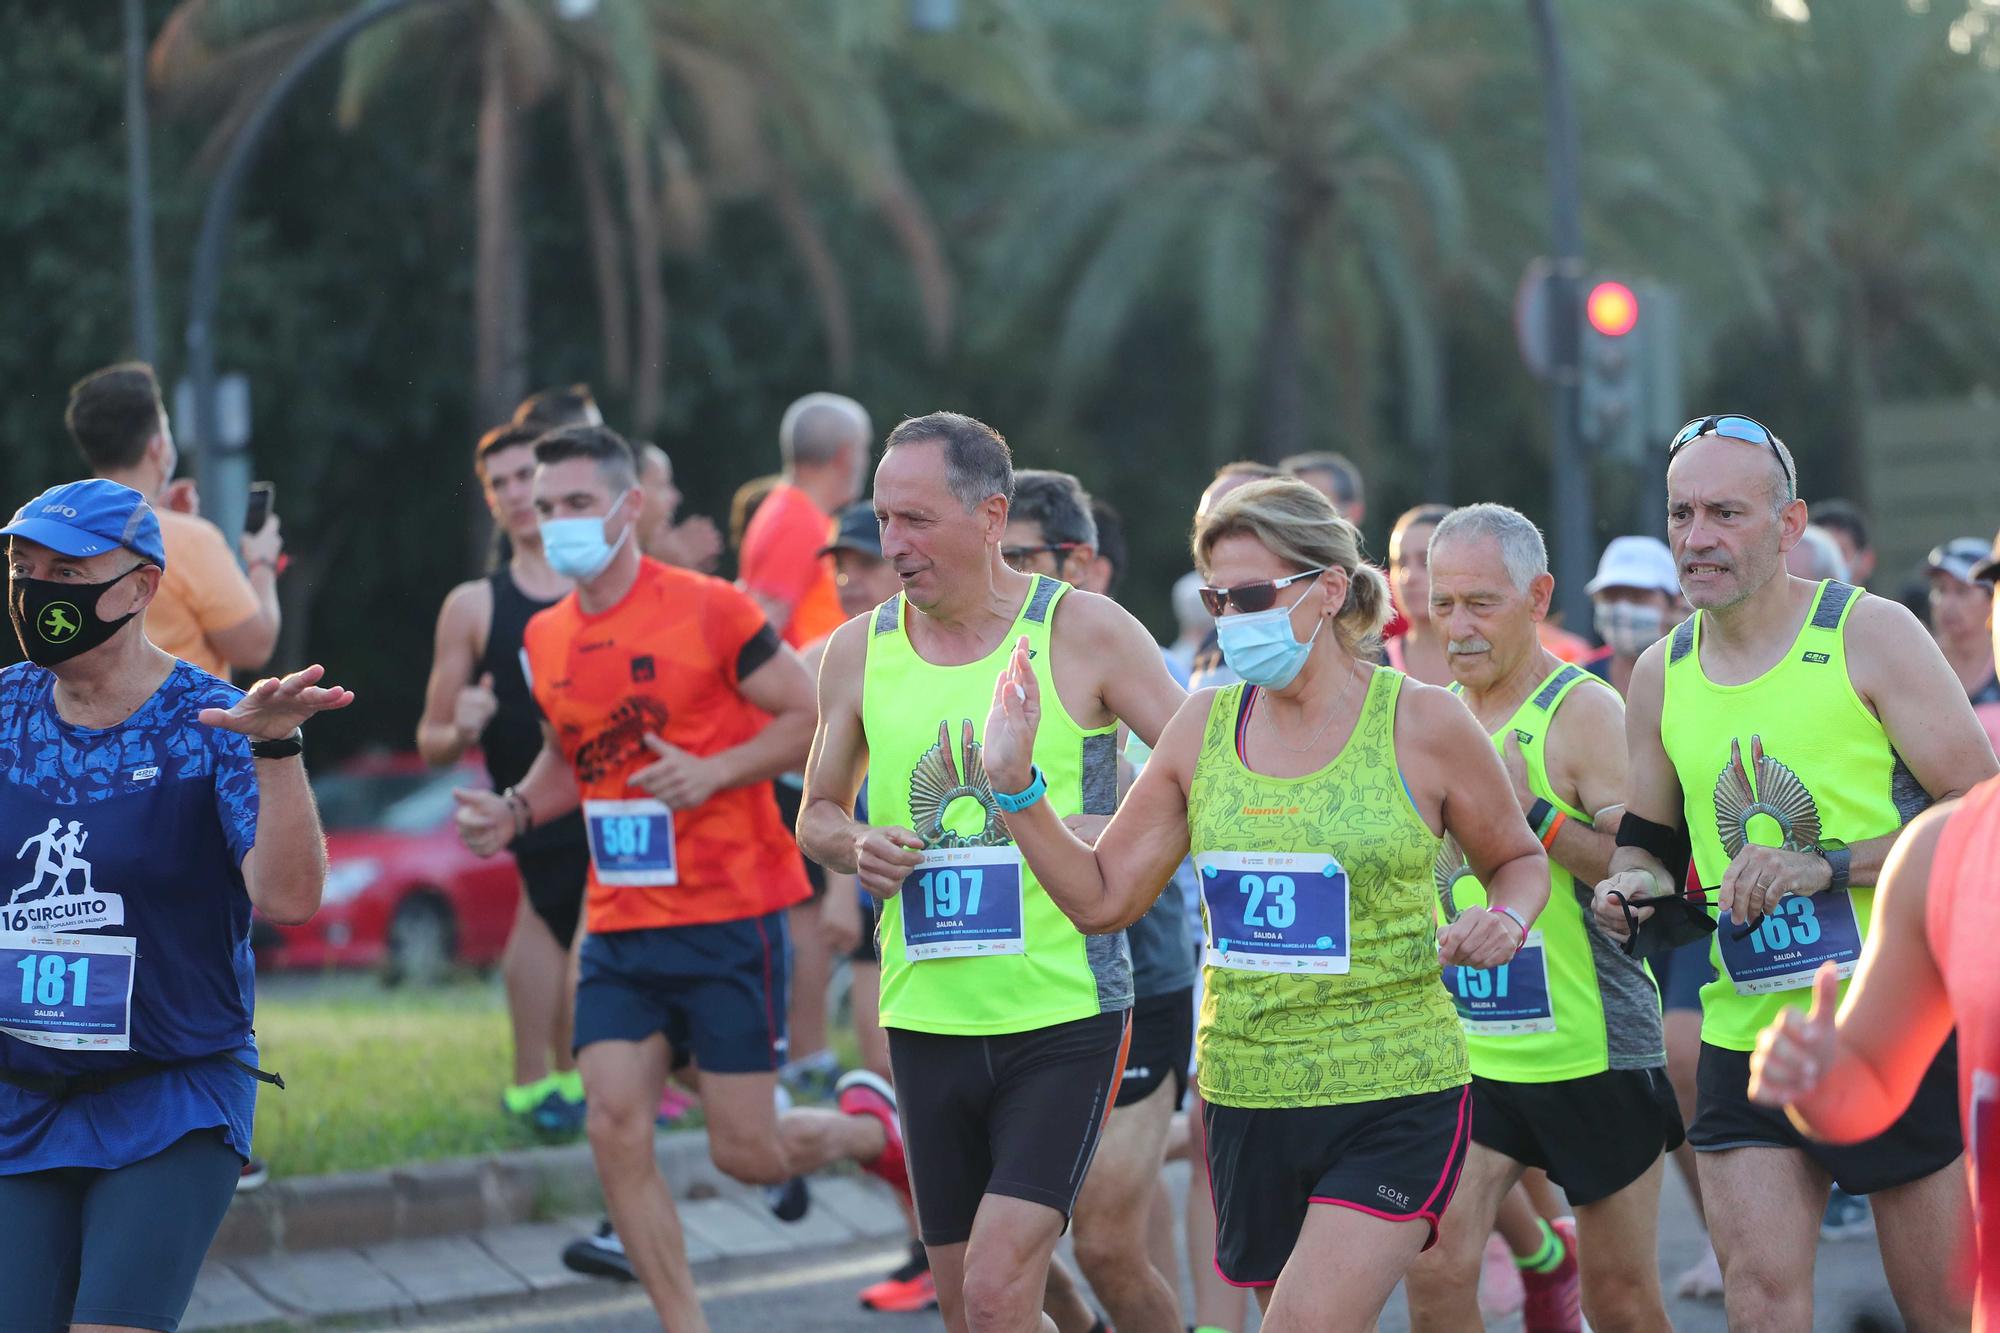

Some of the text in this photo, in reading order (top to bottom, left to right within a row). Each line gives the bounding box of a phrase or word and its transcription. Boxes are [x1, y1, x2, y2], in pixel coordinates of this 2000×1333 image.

[602, 815, 650, 856] 587
[918, 869, 983, 918] 197
[1239, 874, 1296, 929] 23
[2, 900, 106, 931] 16 CIRCUITO
[1254, 931, 1277, 940] SALIDA
[1774, 953, 1796, 962] SALIDA
[17, 954, 90, 1006] 181
[1378, 1184, 1410, 1205] GORE
